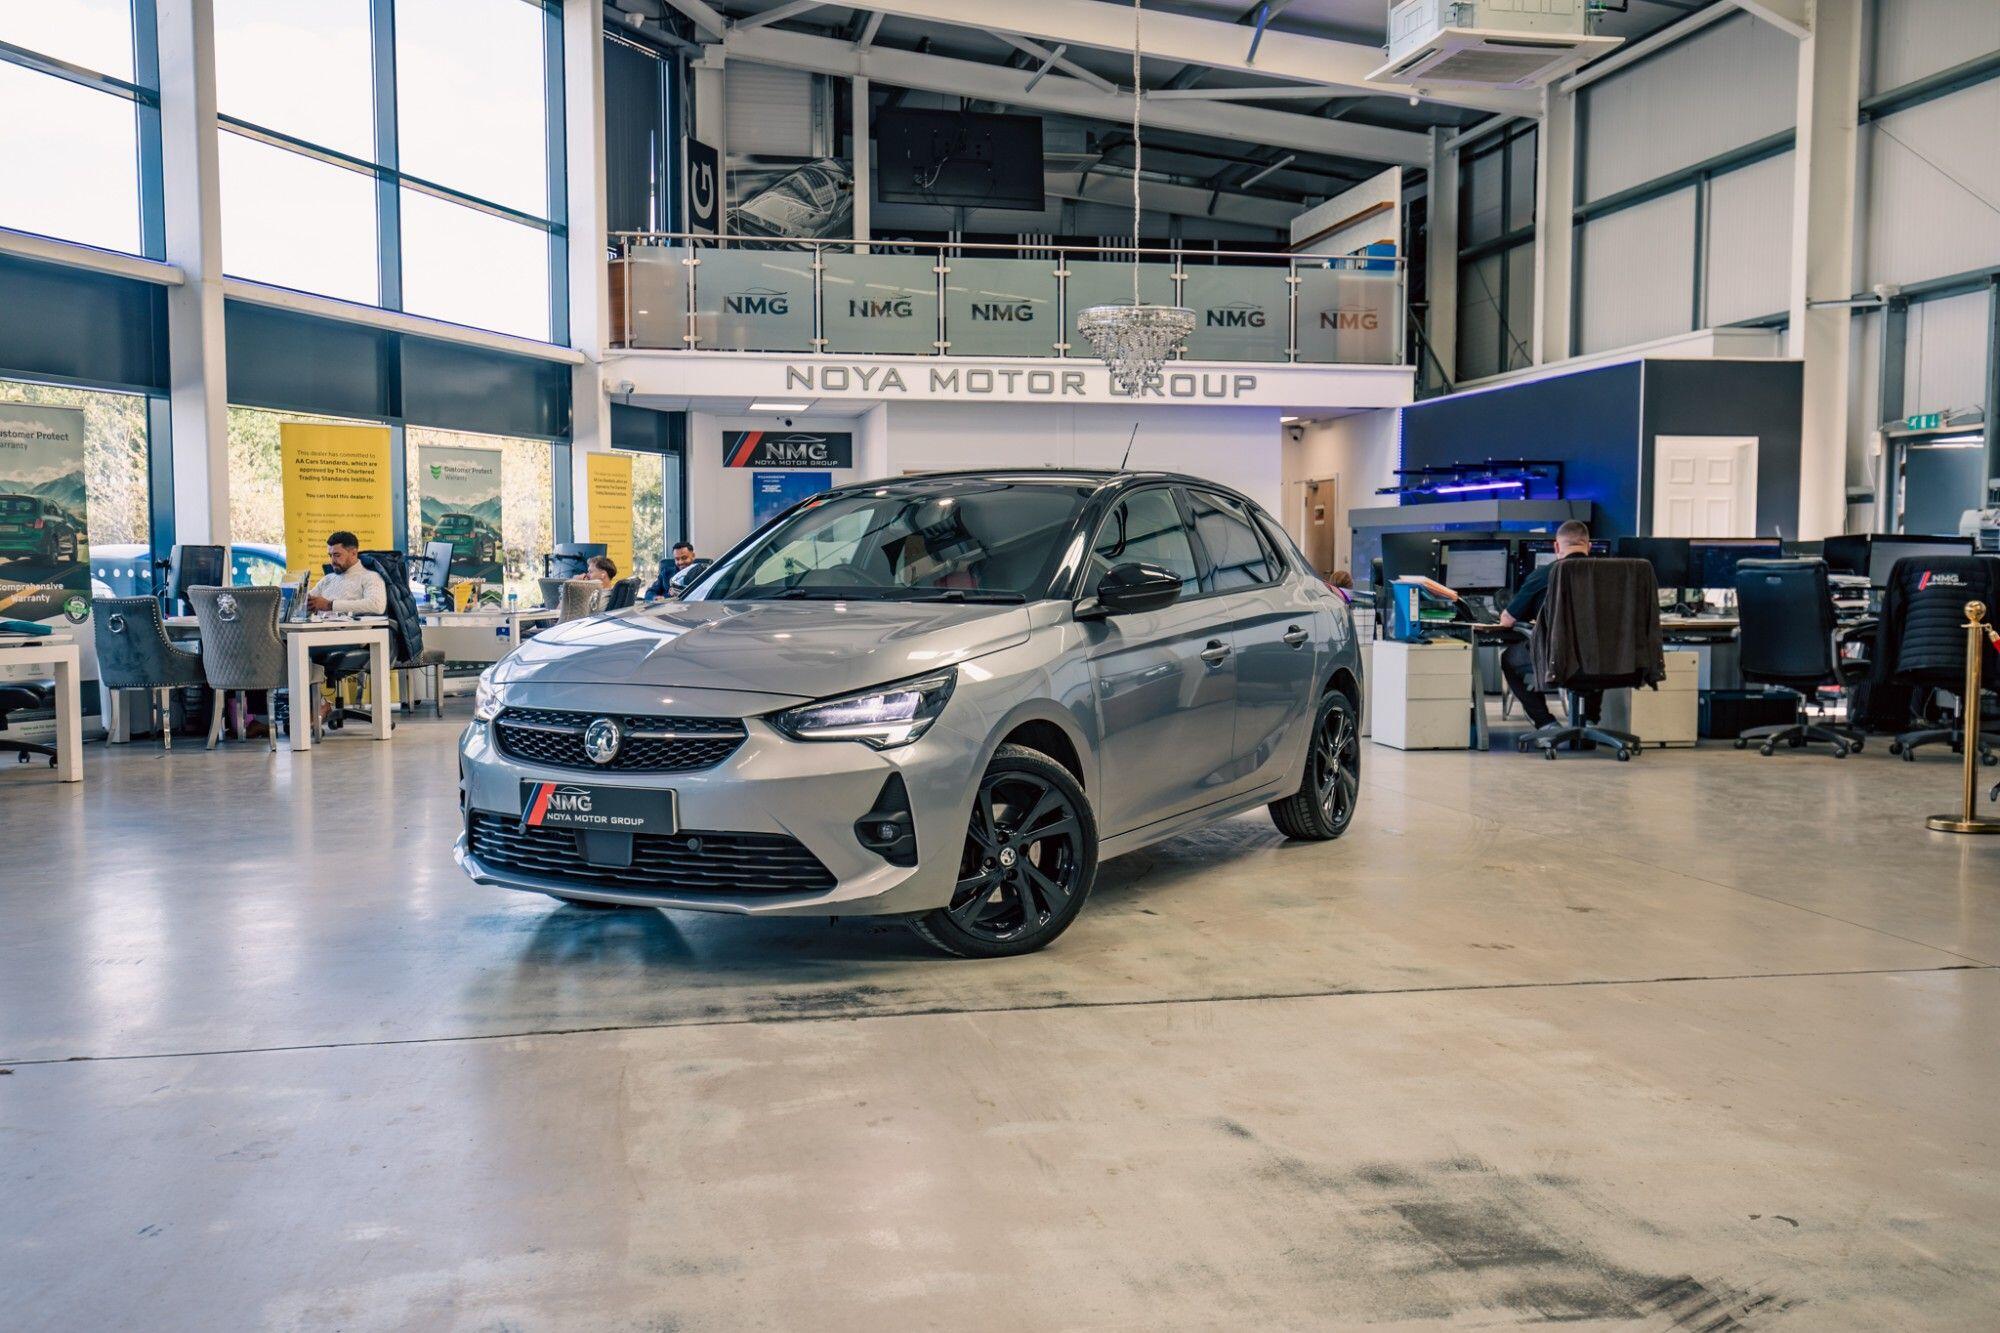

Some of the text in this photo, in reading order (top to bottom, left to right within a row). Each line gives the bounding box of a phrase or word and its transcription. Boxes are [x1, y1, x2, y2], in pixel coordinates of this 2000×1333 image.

[723, 295, 789, 315] NMG
[849, 299, 913, 318] NMG
[971, 303, 1034, 322] NMG
[1206, 309, 1265, 328] NMG
[1319, 311, 1378, 330] NMG
[786, 365, 907, 392] NOYA
[930, 368, 1087, 396] MOTOR
[0, 430, 70, 441] ustomer Protect
[0, 442, 28, 451] arranty
[765, 442, 828, 460] NMG
[1932, 573, 1959, 582] NMG
[546, 793, 592, 811] NMG
[546, 812, 644, 826] NOYA MOTOR GROUP
